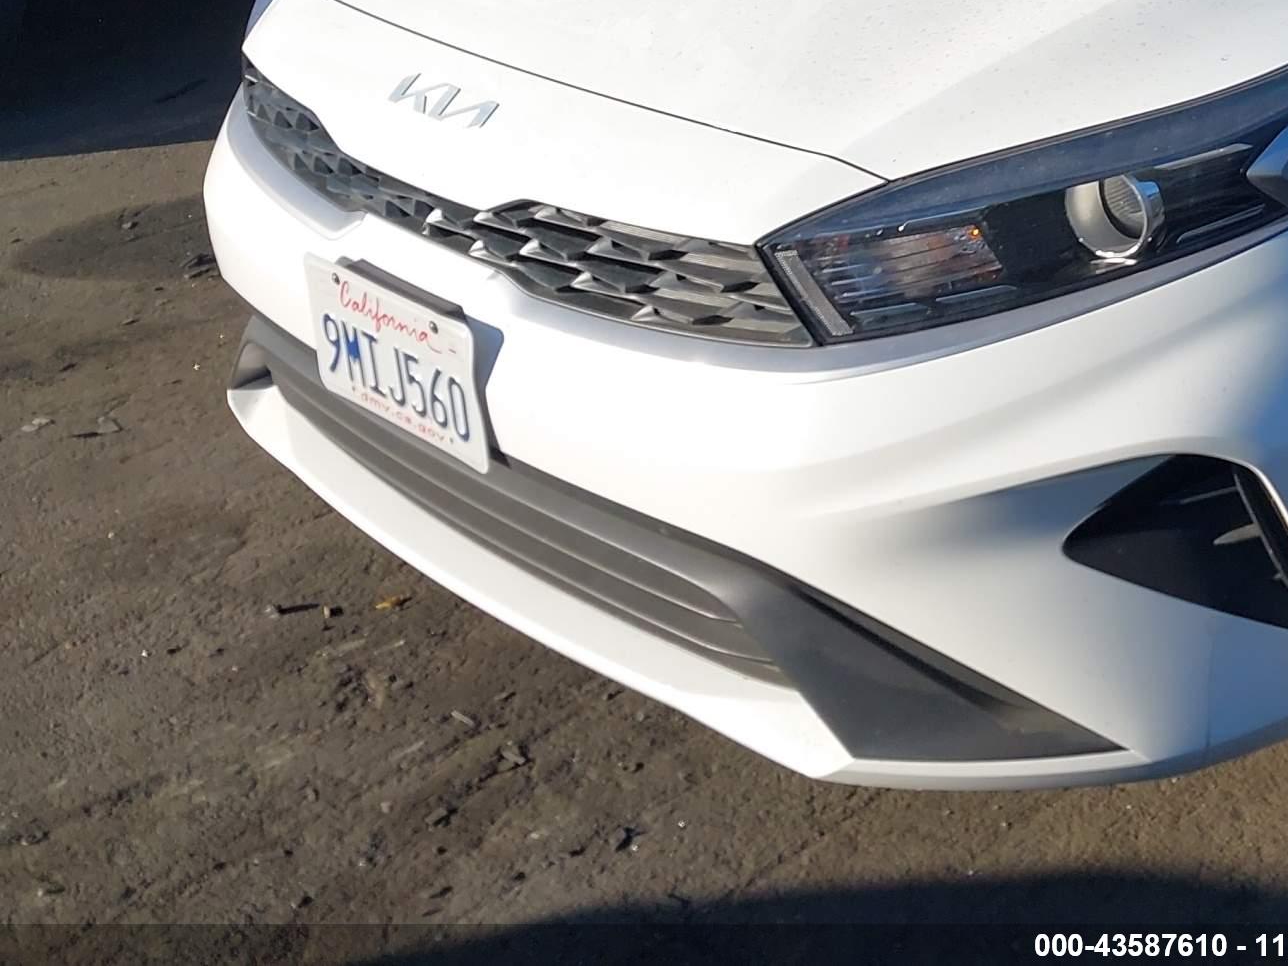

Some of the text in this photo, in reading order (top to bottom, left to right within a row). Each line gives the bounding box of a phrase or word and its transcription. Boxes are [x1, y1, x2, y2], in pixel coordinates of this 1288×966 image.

[388, 72, 500, 129] KIA
[339, 281, 443, 354] California
[323, 313, 470, 443] 9MIJ560
[360, 391, 446, 444] dmv.ca.gov
